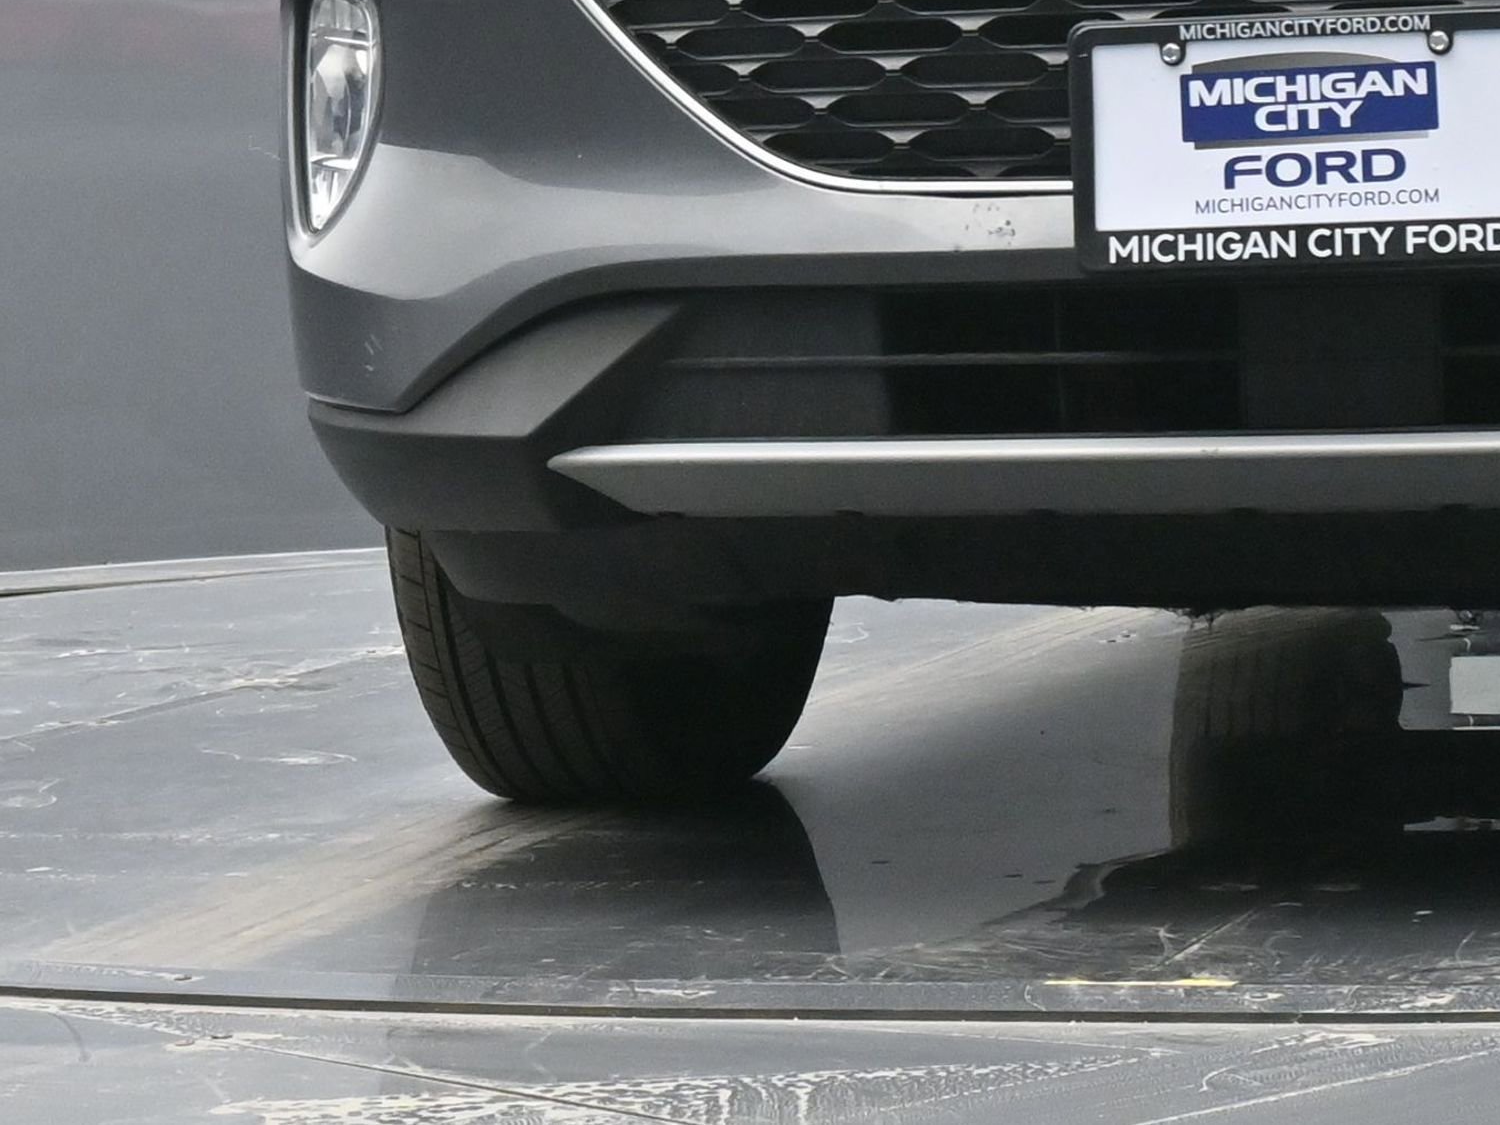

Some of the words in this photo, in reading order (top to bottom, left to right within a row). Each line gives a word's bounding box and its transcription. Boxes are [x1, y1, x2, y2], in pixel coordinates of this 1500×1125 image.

[1179, 15, 1431, 41] MICHIGANCITYFORD.COM
[1188, 68, 1429, 107] MICHIGAN
[1254, 100, 1364, 132] CITY
[1223, 147, 1406, 190] FORD
[1195, 188, 1440, 215] MICHIGANCITYFORD.COM
[1108, 230, 1298, 264] MICHIGAN
[1307, 226, 1395, 257] CITY
